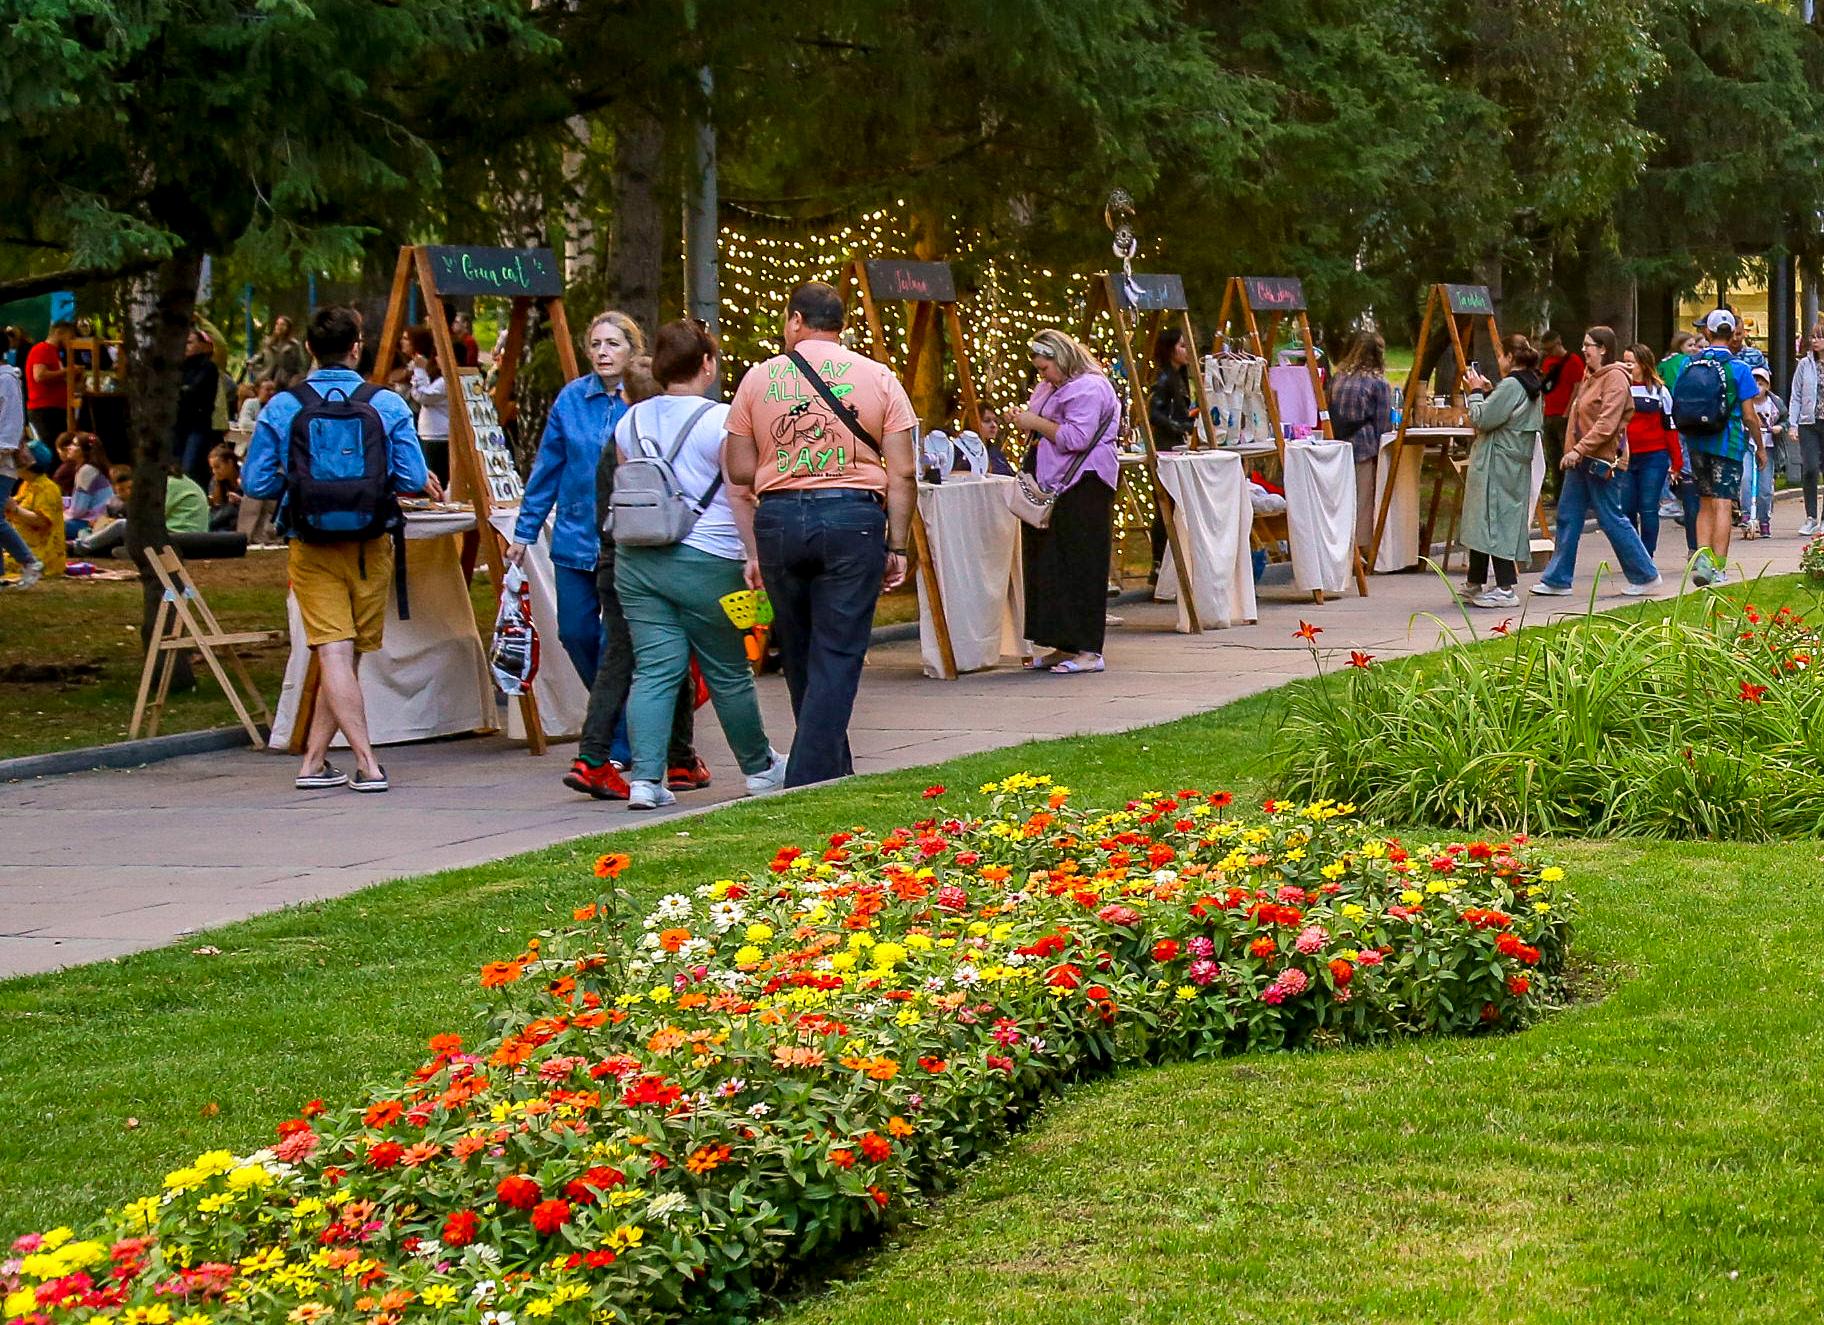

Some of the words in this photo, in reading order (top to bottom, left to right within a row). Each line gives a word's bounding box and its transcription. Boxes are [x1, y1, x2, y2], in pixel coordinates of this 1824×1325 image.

[768, 360, 852, 379] VAAY
[764, 381, 810, 402] ALL
[777, 447, 846, 472] DAY!
